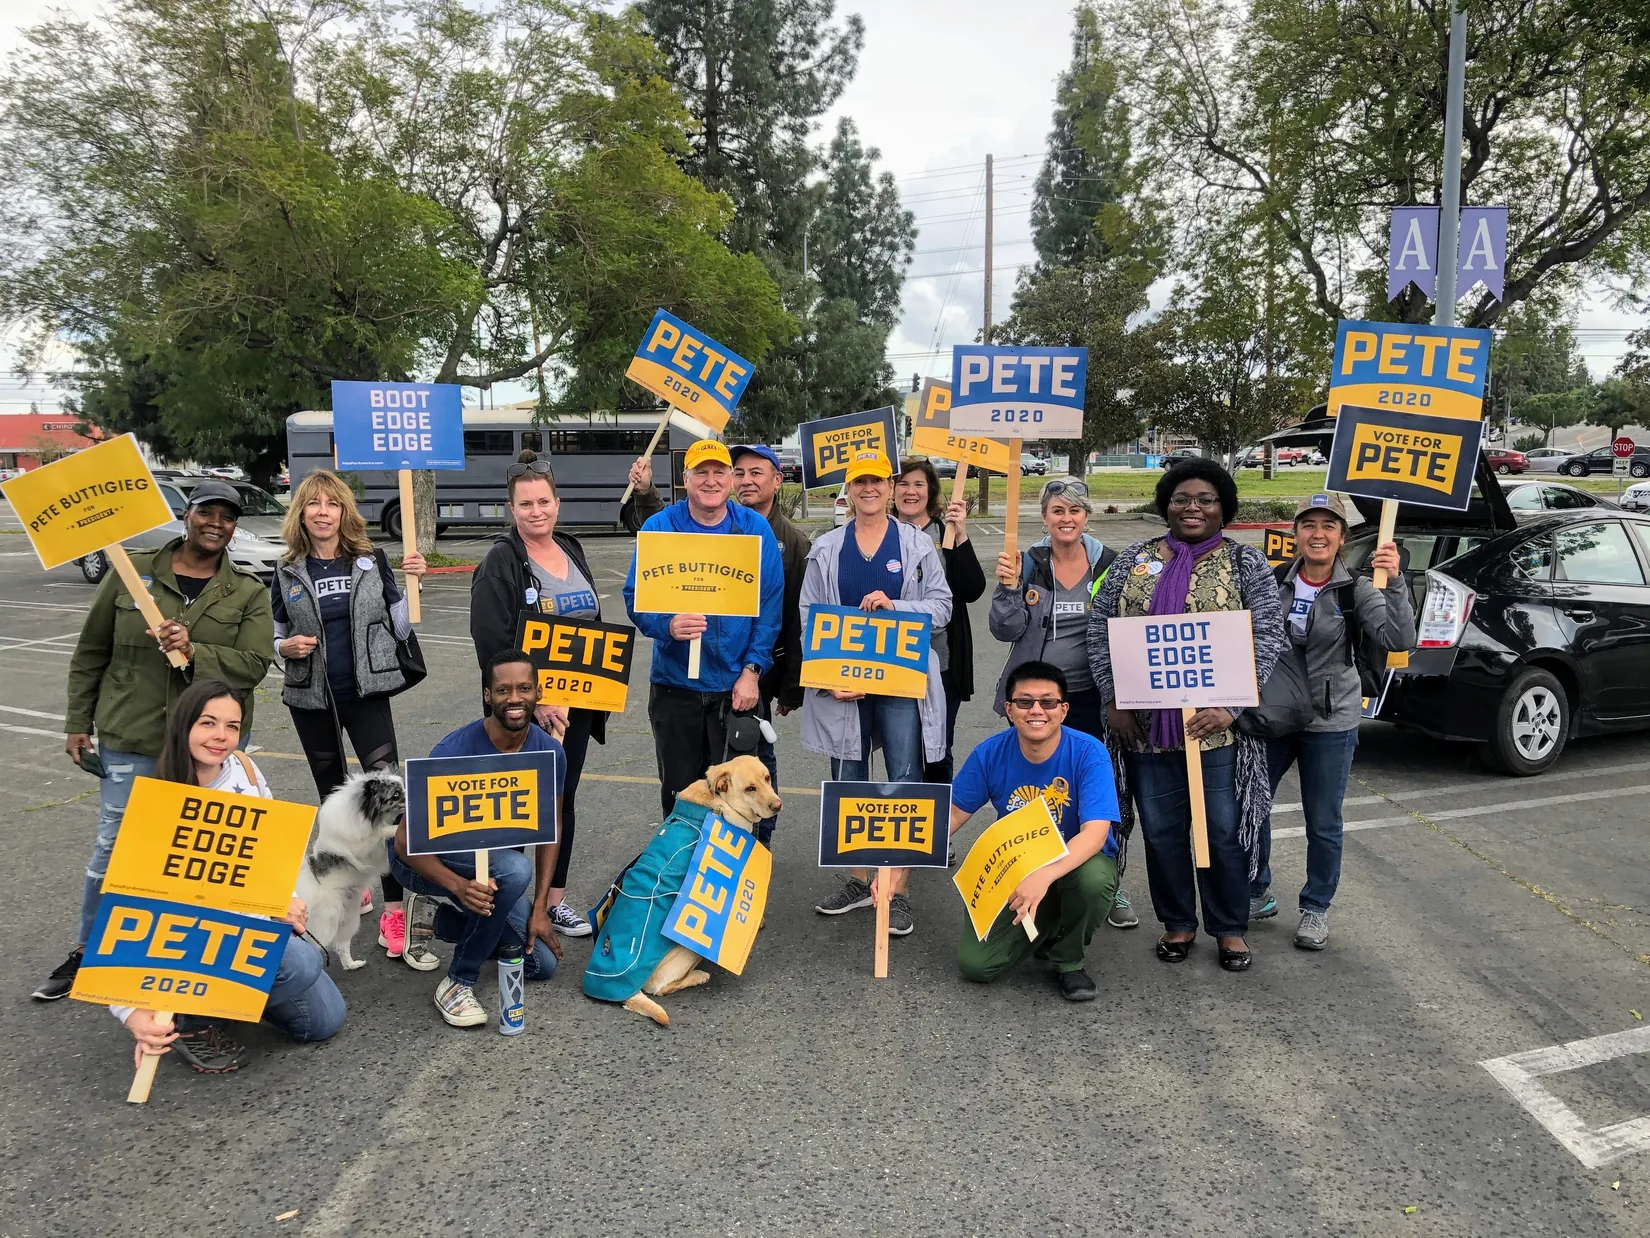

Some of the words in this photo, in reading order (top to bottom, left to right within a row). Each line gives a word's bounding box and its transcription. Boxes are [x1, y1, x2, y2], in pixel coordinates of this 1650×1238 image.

[1395, 216, 1430, 270] A
[1462, 216, 1498, 270] A
[646, 319, 747, 401] PETE
[1341, 331, 1481, 384] PETE
[959, 355, 1080, 398] PETE
[370, 389, 430, 408] BOOT
[663, 375, 700, 403] 2020
[1378, 390, 1431, 407] 2020
[371, 411, 431, 430] EDGE
[990, 409, 1043, 423] 2020
[373, 433, 433, 452] EDGE
[825, 432, 850, 443] VOTE
[852, 428, 872, 439] FOR
[947, 436, 988, 455] 2020
[1373, 430, 1411, 447] VOTE
[1413, 437, 1442, 450] FOR
[1613, 443, 1634, 452] STOP
[1355, 442, 1452, 483] PETE
[30, 504, 60, 533] PETE
[59, 478, 149, 510] BUTTIGIEG
[83, 505, 96, 513] FOR
[1267, 533, 1296, 558] PE
[642, 564, 674, 581] PETE
[679, 563, 755, 584] BUTTIGIEG
[317, 579, 352, 594] PETE
[559, 592, 595, 610] PETE
[1055, 603, 1083, 612] PETE
[811, 612, 925, 661] PETE
[1145, 621, 1211, 643] BOOT
[521, 620, 629, 673] PETE
[1147, 645, 1213, 667] EDGE
[841, 665, 885, 681] 2020
[1149, 668, 1215, 690] EDGE
[545, 677, 592, 693] 2020
[447, 778, 486, 792] VOTE
[490, 776, 519, 789] FOR
[180, 796, 268, 831] BOOT
[436, 788, 531, 828] PETE
[856, 802, 892, 814] VOTE
[893, 803, 918, 814] FOR
[845, 815, 928, 844] PETE
[171, 825, 259, 860] EDGE
[162, 853, 250, 888] EDGE
[970, 874, 986, 909] PETE
[984, 826, 1050, 875] BUTTIGIEG
[109, 883, 169, 895] PeteForAmerica.com
[674, 819, 747, 949] PETE
[735, 879, 756, 924] 2020
[97, 904, 280, 978] PETE
[140, 975, 208, 997] 2020
[75, 991, 151, 1006] PeteForAmerica.com
